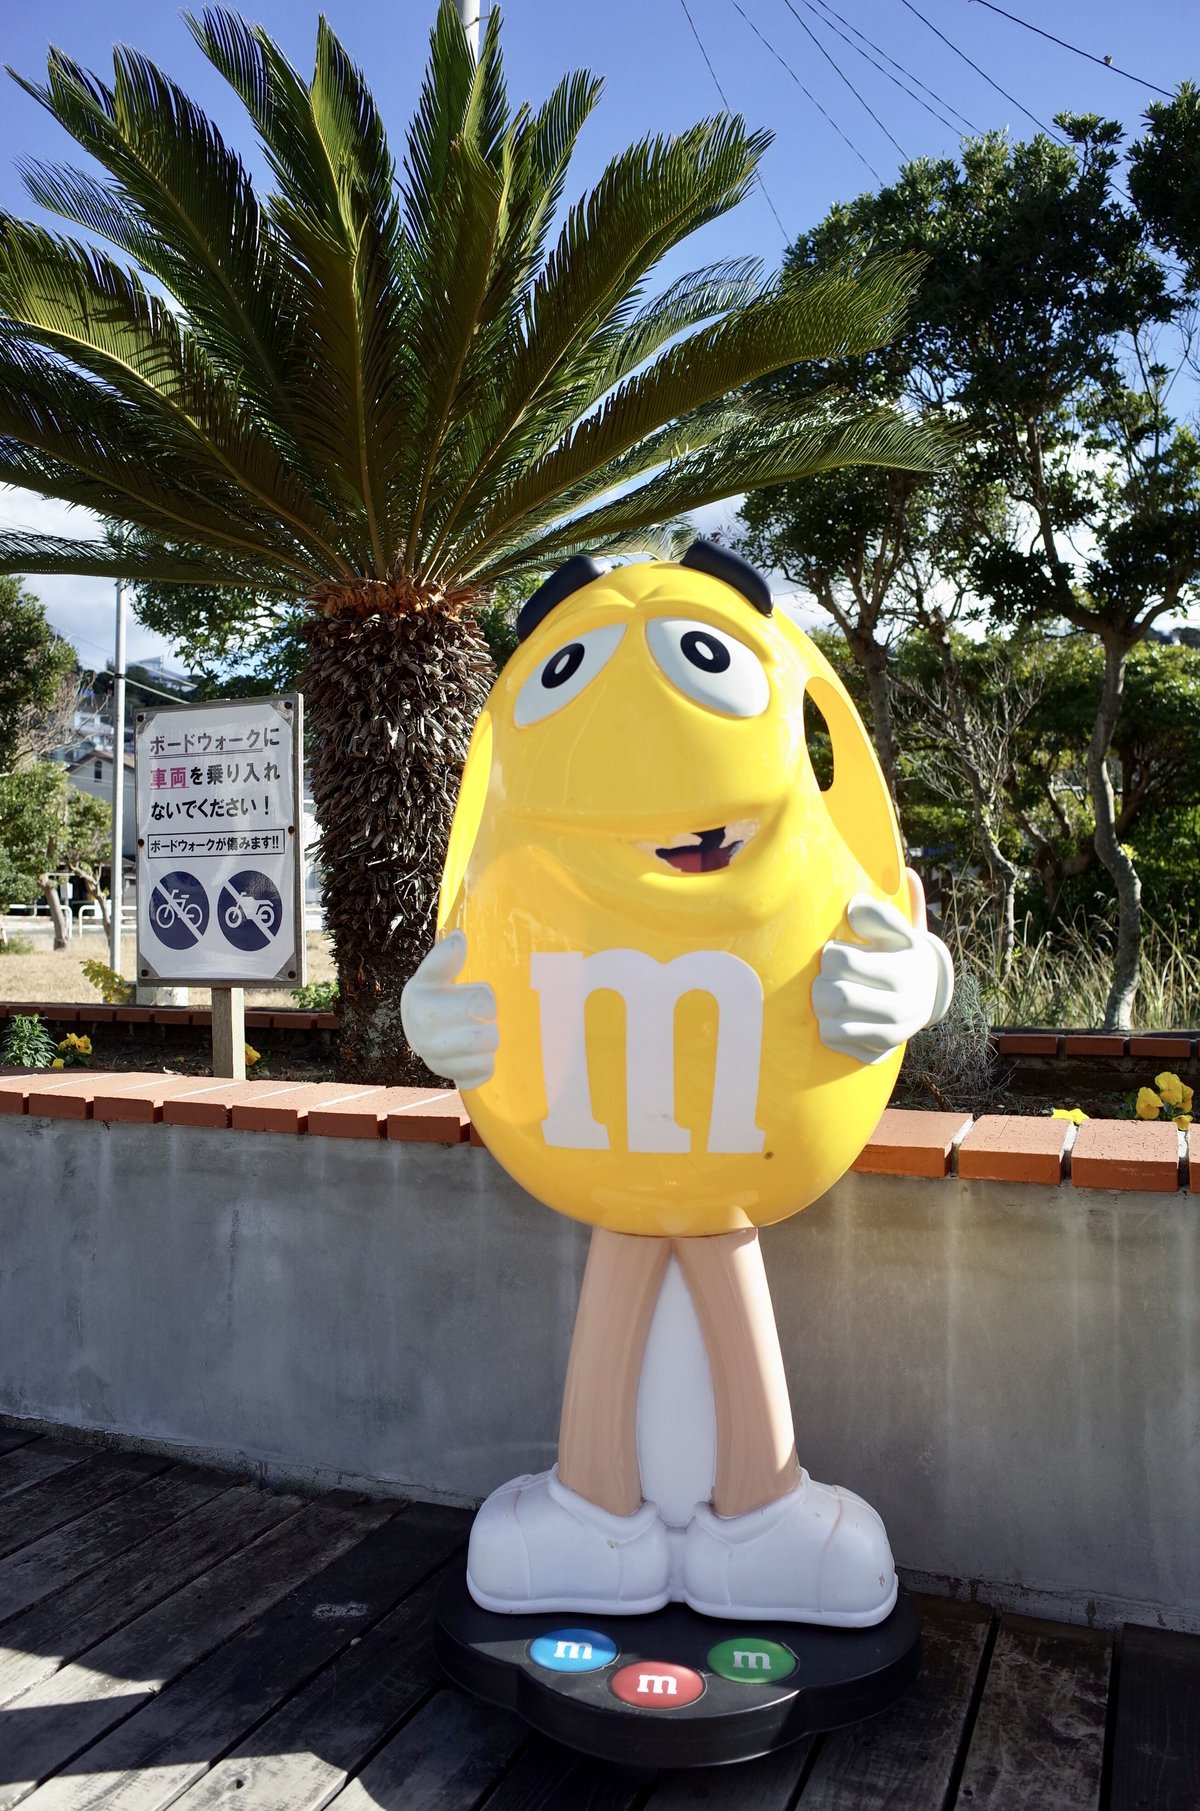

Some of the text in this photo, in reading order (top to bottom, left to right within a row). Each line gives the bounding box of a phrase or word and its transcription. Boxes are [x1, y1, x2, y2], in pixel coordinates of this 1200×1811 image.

[149, 727, 280, 755] ボードウォークに
[150, 762, 280, 789] 車両を乗り入れ
[530, 948, 766, 1153] m
[554, 1640, 592, 1659] m
[732, 1651, 771, 1670] m
[637, 1674, 677, 1694] m
